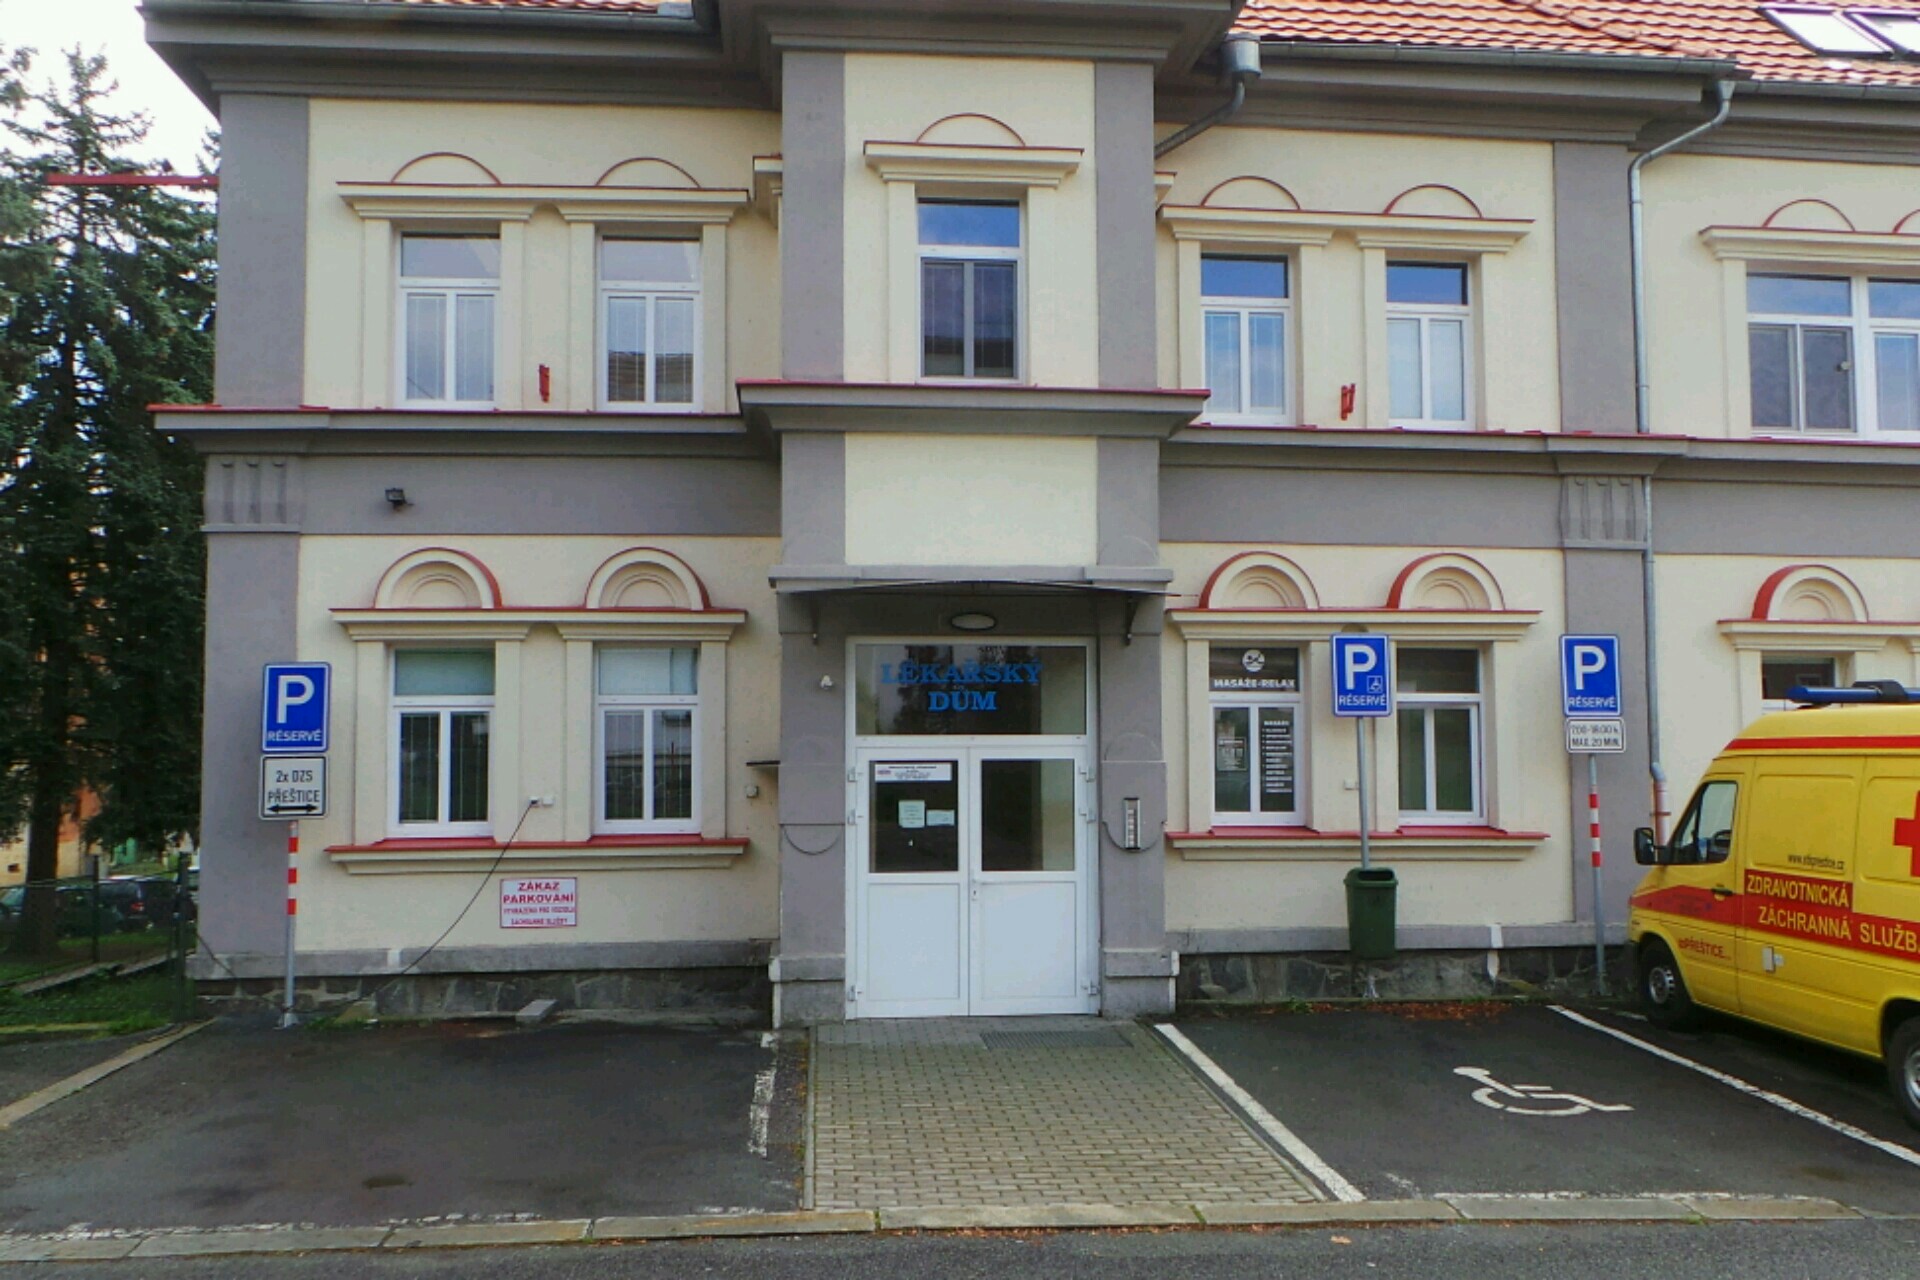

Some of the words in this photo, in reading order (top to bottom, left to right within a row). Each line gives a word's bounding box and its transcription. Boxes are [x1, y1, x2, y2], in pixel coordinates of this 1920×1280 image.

[1344, 643, 1378, 690] P
[1573, 645, 1607, 690] P
[276, 674, 316, 724] P
[1339, 693, 1387, 706] RÉSERVÉ
[1567, 695, 1617, 708] RÉSERVÉ
[267, 729, 322, 742] RÉSERVÉ
[275, 770, 289, 783] 2x
[267, 788, 320, 803] PŘEŠTICE
[518, 881, 561, 892] ZÁKAZ
[1747, 874, 1850, 907] ZDRAVOTNICKÁ
[1758, 903, 1852, 941] ZÁCHRANNÁ
[1859, 921, 1920, 954] SLUŽB
